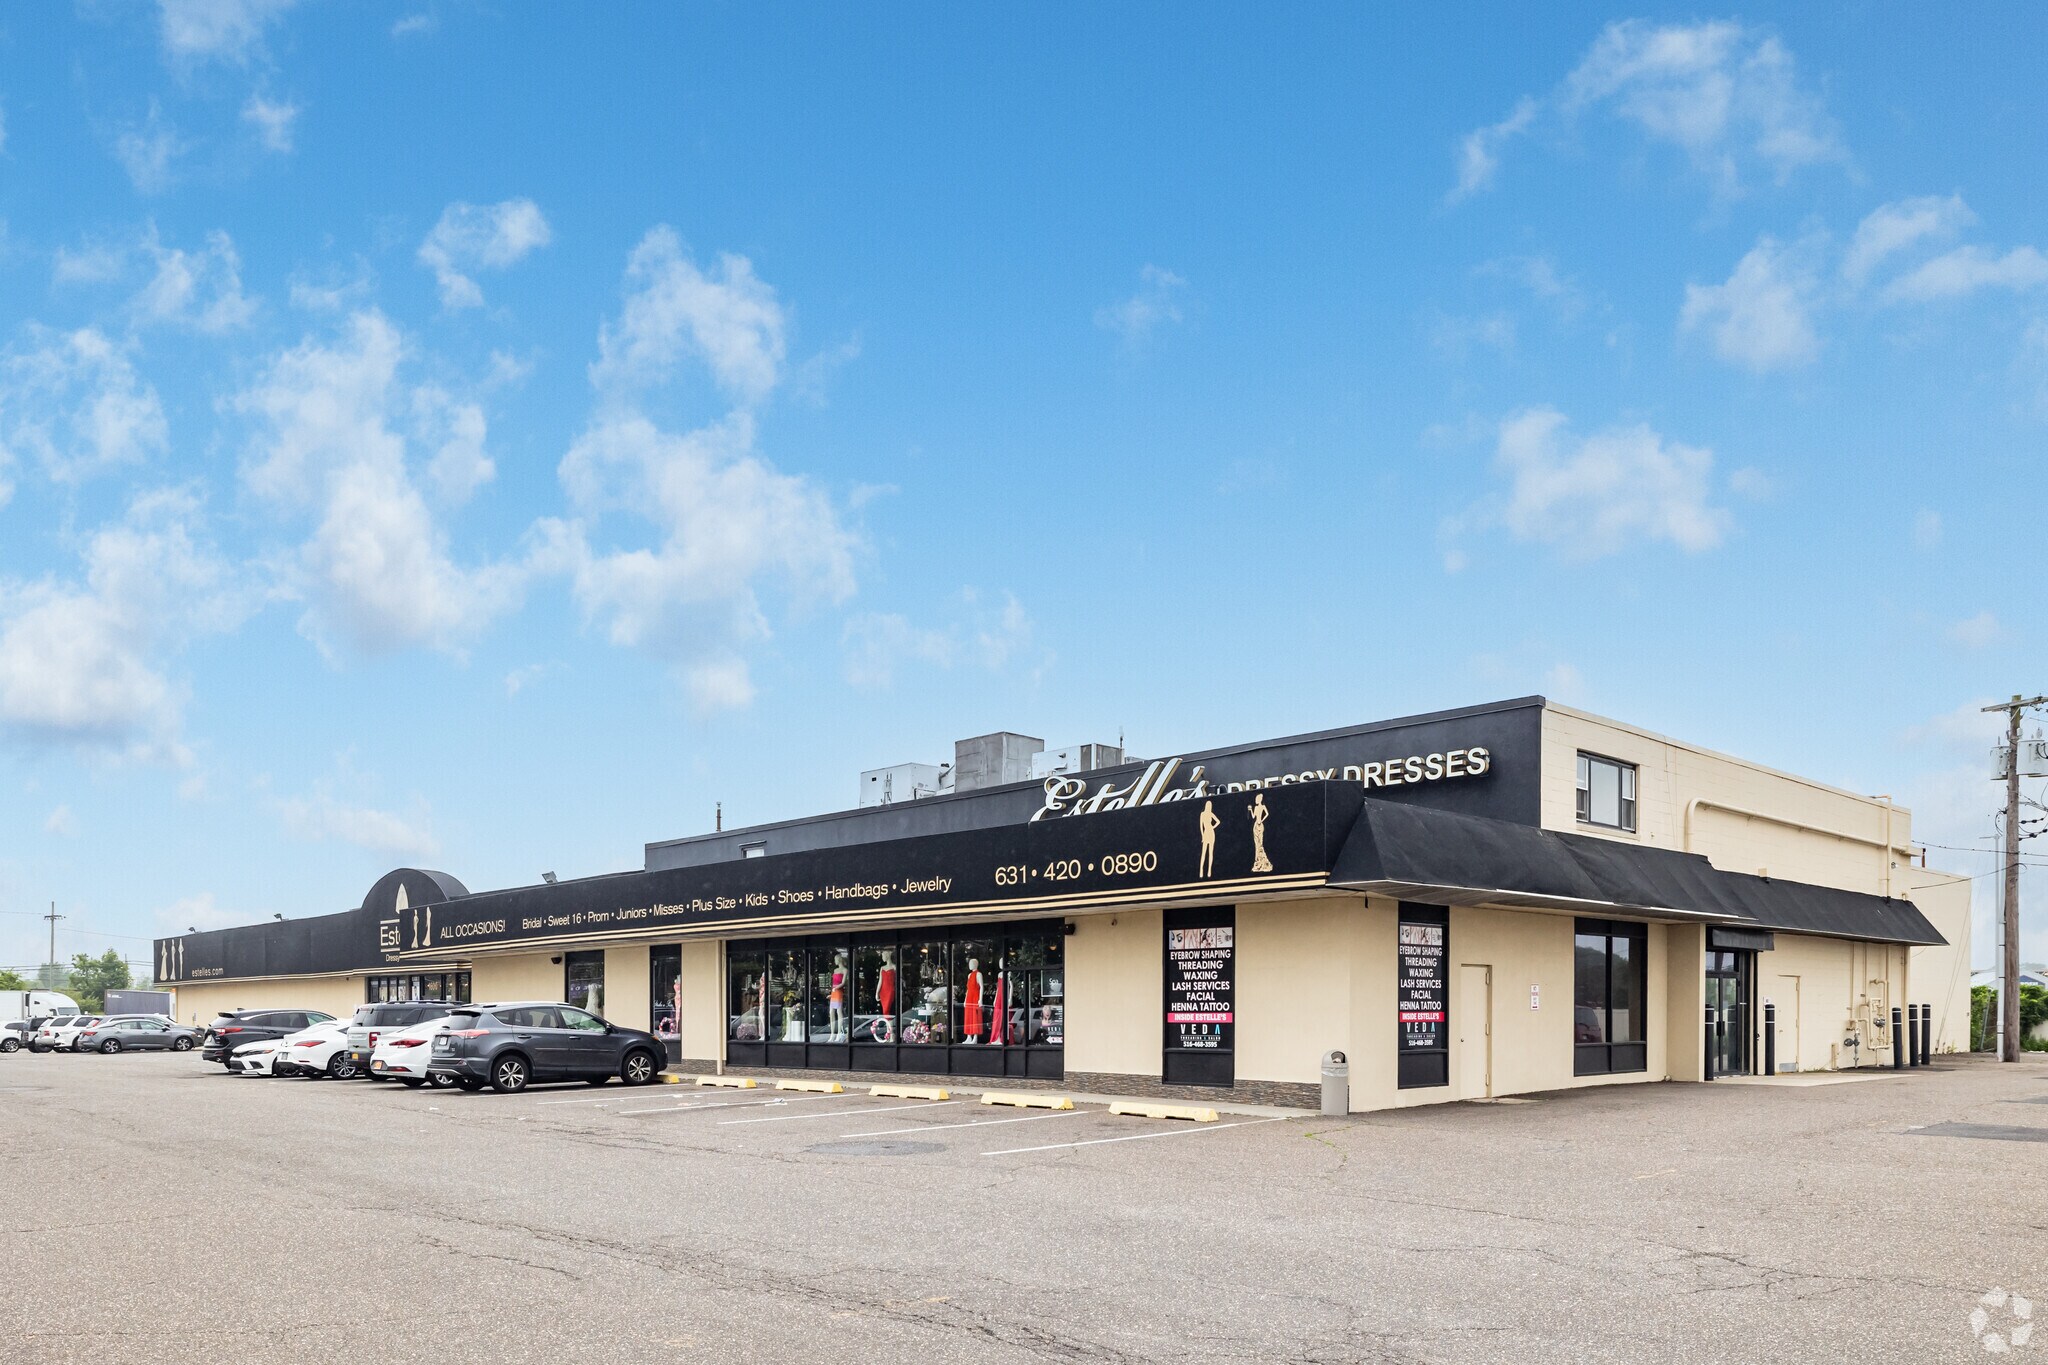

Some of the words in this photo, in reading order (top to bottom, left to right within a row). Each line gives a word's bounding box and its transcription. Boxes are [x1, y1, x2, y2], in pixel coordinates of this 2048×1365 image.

[1343, 747, 1490, 789] DRESSES
[995, 865, 1027, 886] 631
[1043, 859, 1081, 881] 420
[1101, 851, 1157, 876] 0890
[522, 917, 542, 930] Bridal
[547, 914, 570, 927] Sweet
[572, 913, 582, 924] 16
[587, 911, 609, 923] Prom
[616, 907, 647, 920] Juniors
[653, 903, 684, 916] Misses
[692, 899, 713, 912] Plus
[715, 897, 736, 910] Size
[745, 893, 768, 907] Kids
[778, 889, 814, 904] Shoes
[825, 882, 889, 900] Handbags
[901, 876, 952, 894] Jewelry
[440, 927, 454, 939] ALL
[455, 919, 506, 937] OCCASIONS!
[380, 926, 400, 946] Est
[1170, 950, 1200, 960] EYEBROW
[1201, 949, 1231, 959] SHAPING
[1400, 946, 1421, 956] EYEBROW
[1422, 947, 1442, 956] SHAPING
[1178, 960, 1224, 970] THREADING
[1405, 957, 1437, 967] THREADING
[191, 967, 224, 977] estelles.com
[1183, 971, 1218, 980] WAXING
[1409, 968, 1434, 978] WAXING
[1172, 982, 1192, 991] LASH
[1193, 981, 1230, 990] SERVICES
[1400, 979, 1415, 988] LASH
[1416, 979, 1442, 988] SERVICES
[1186, 992, 1215, 1001] FACIAL
[1411, 990, 1432, 1000] FACIAL
[1171, 1002, 1198, 1011] HENNA
[1199, 1002, 1230, 1011] TATTOO
[1400, 1001, 1420, 1010] HENNA
[1420, 1001, 1442, 1010] TATTOO
[1174, 1013, 1194, 1021] INSIDE
[1195, 1013, 1227, 1021] ESTELLE'S
